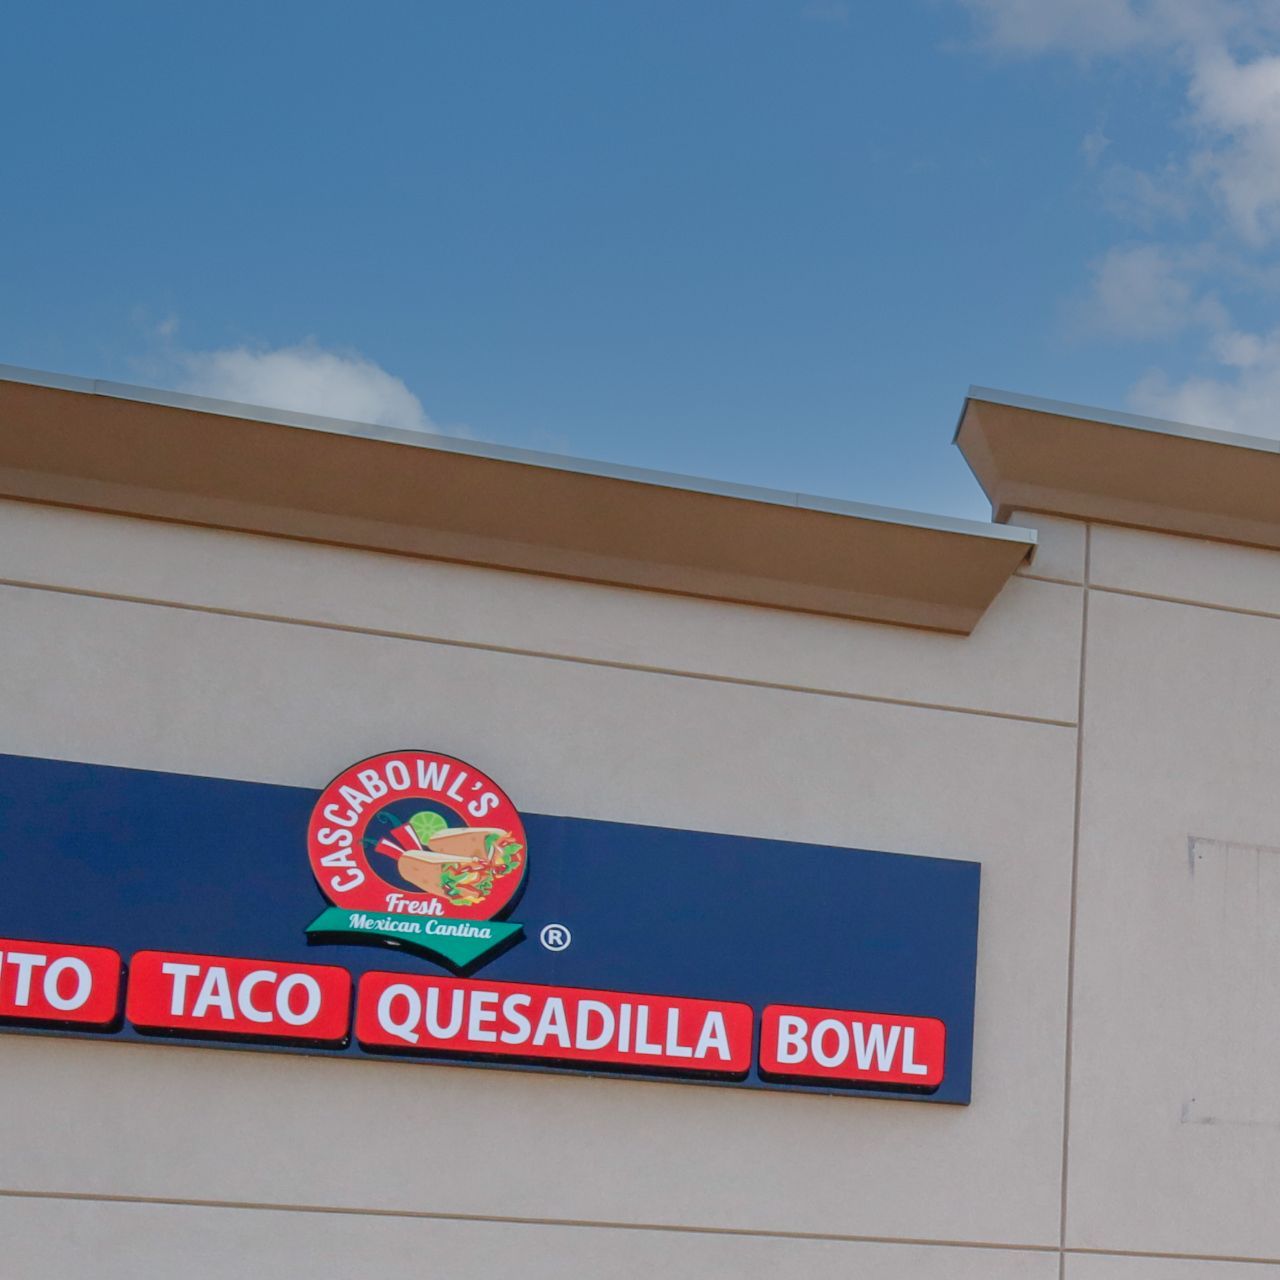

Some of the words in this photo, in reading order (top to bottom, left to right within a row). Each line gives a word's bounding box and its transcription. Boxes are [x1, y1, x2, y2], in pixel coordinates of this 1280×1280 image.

[317, 759, 499, 893] CASCABOWL'S
[349, 913, 422, 935] Mexican
[424, 920, 492, 939] Cantina
[385, 893, 444, 916] Fresh
[0, 952, 92, 1011] TO
[162, 962, 322, 1026] TACO
[376, 981, 732, 1063] QUESADILLA
[776, 1015, 928, 1077] BOWL
